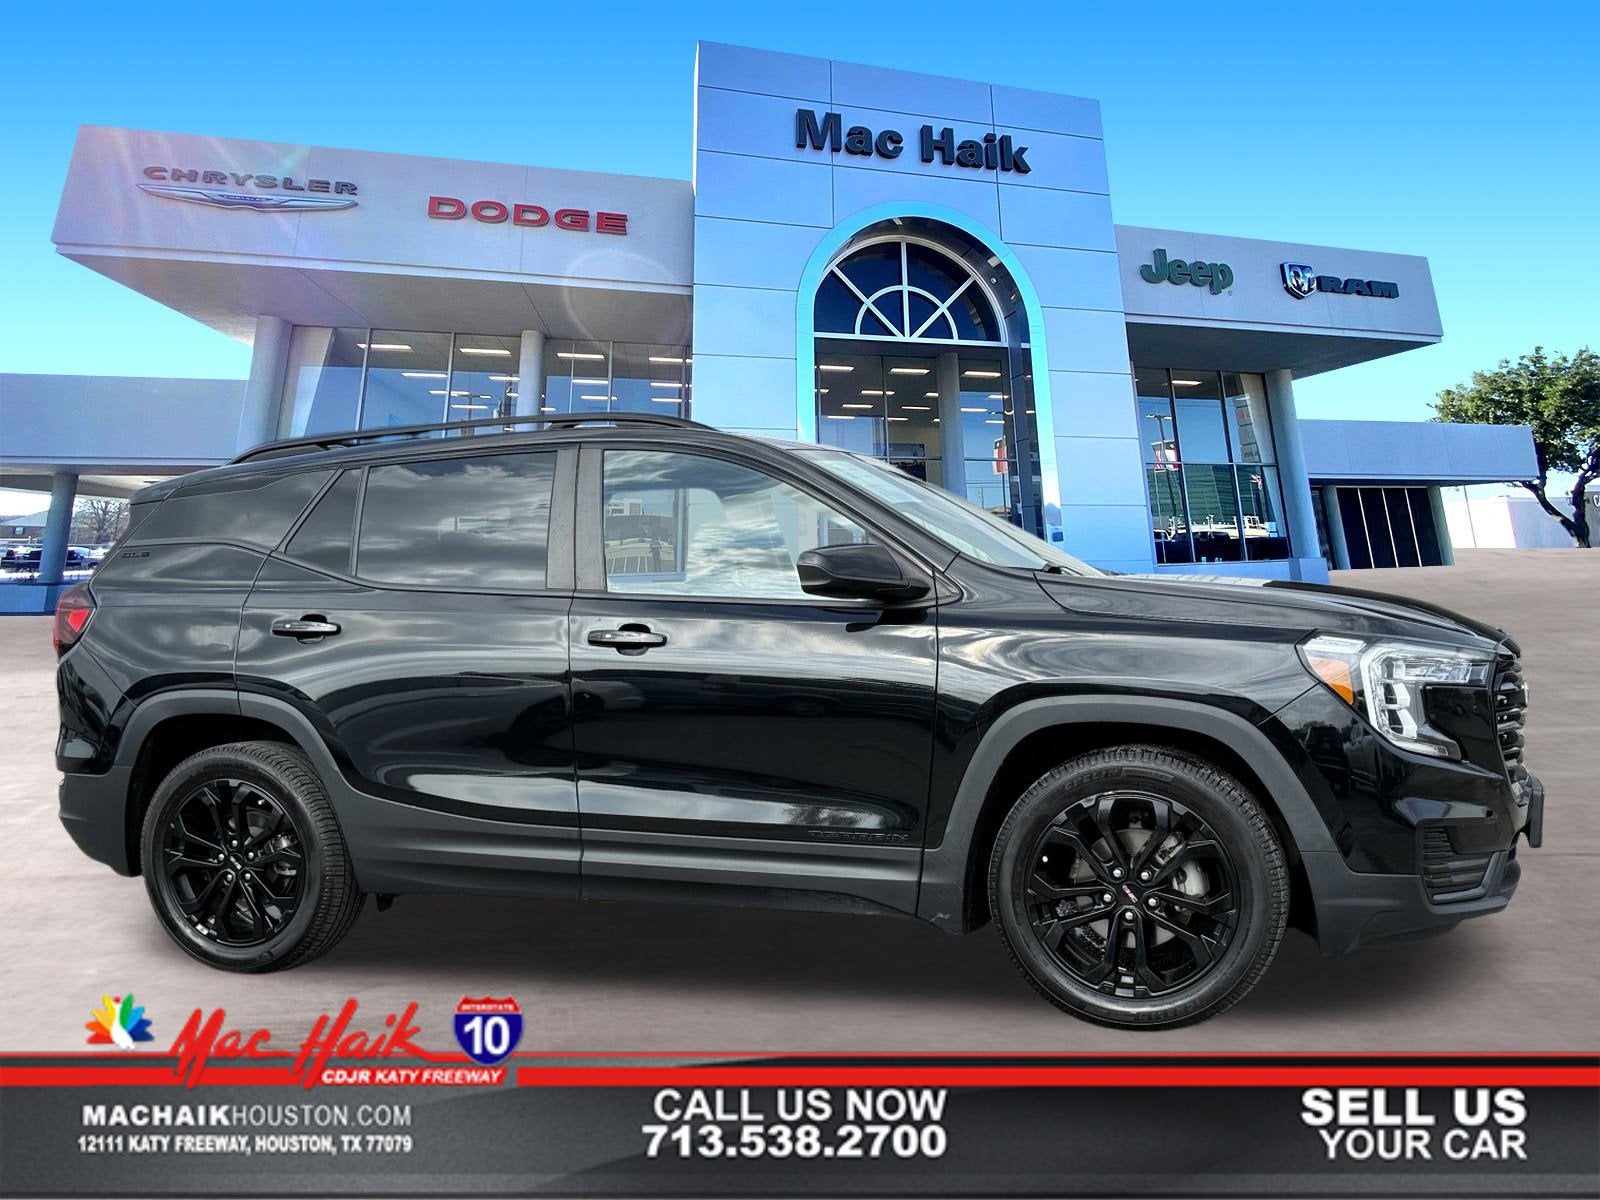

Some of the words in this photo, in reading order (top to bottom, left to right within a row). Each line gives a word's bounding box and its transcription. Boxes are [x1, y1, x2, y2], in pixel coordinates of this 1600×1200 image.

[796, 108, 904, 159] Mac
[919, 125, 1032, 174] Haik
[143, 166, 359, 196] CHRYSLER
[428, 196, 628, 236] DODGE
[1140, 248, 1234, 295] Jeep
[1316, 275, 1400, 299] RAM
